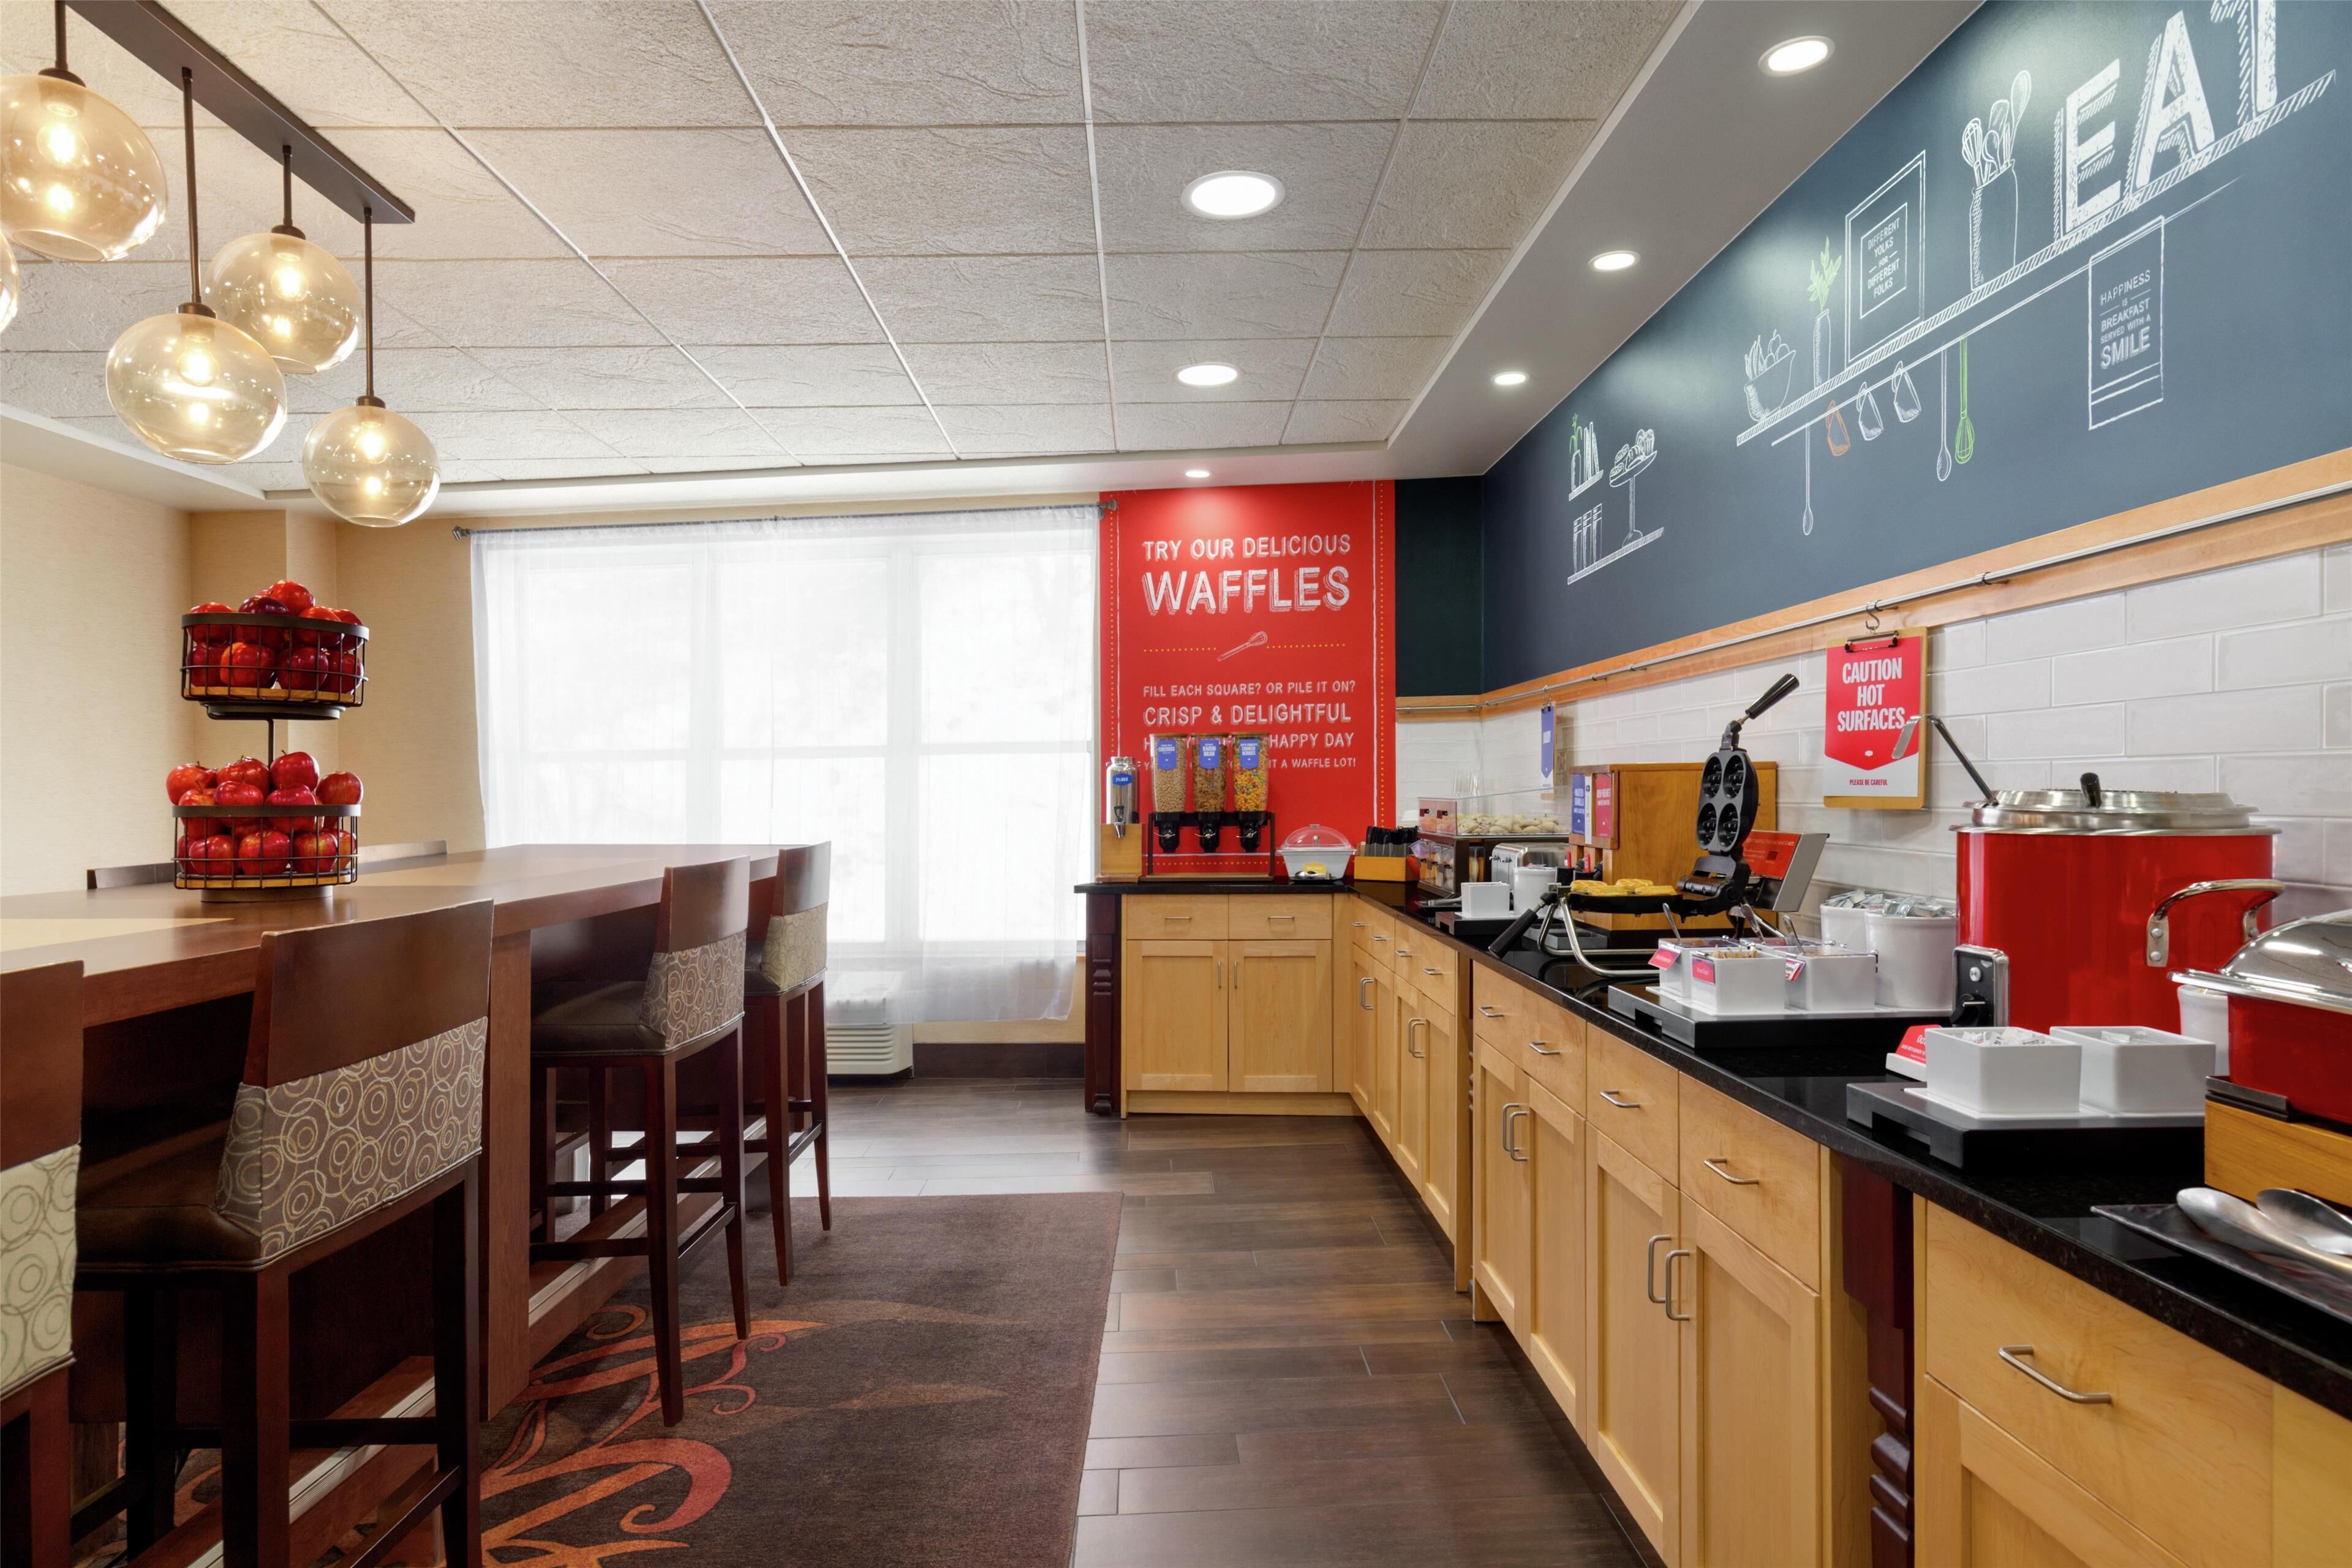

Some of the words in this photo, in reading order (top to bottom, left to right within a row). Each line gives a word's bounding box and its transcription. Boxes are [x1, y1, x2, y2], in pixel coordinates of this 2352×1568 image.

[1868, 217, 1900, 250] DIFFERENT
[1874, 236, 1894, 257] YOLKS
[1868, 258, 1900, 289] DIFFERENT
[1879, 255, 1888, 268] FOR
[1873, 277, 1893, 299] FOLKS
[2100, 270, 2151, 306] HAPPINESS
[2122, 298, 2128, 307] IS
[2101, 298, 2151, 333] BREAKFAST
[2100, 326, 2125, 344] SERVED
[2127, 316, 2144, 331] WITH
[2146, 314, 2151, 322] A
[2100, 326, 2151, 369] SMILE
[1142, 540, 1182, 561] TRY
[1190, 538, 1234, 560] OUR
[1242, 534, 1351, 559] DELICIOUS
[1142, 565, 1350, 616] WAFFLES
[1842, 657, 1902, 684] CAUTION
[1143, 685, 1166, 697] FILL
[1170, 684, 1202, 696] EACH
[1207, 682, 1261, 695] SQUARE?
[1266, 682, 1283, 694] OR
[1287, 681, 1313, 693] PILE
[1317, 681, 1328, 693] IT
[1332, 680, 1356, 692] ON?
[1857, 684, 1885, 707] HOT
[1143, 706, 1203, 726] CRISP
[1210, 705, 1223, 725] &
[1231, 703, 1352, 725] DELIGHTFUL
[1838, 707, 1905, 732] SURFACES
[1269, 734, 1319, 749] HAPPY
[1325, 732, 1354, 748] DAY
[1281, 759, 1288, 768] A
[1292, 758, 1330, 768] WAFFLE
[1334, 757, 1357, 767] LOT!
